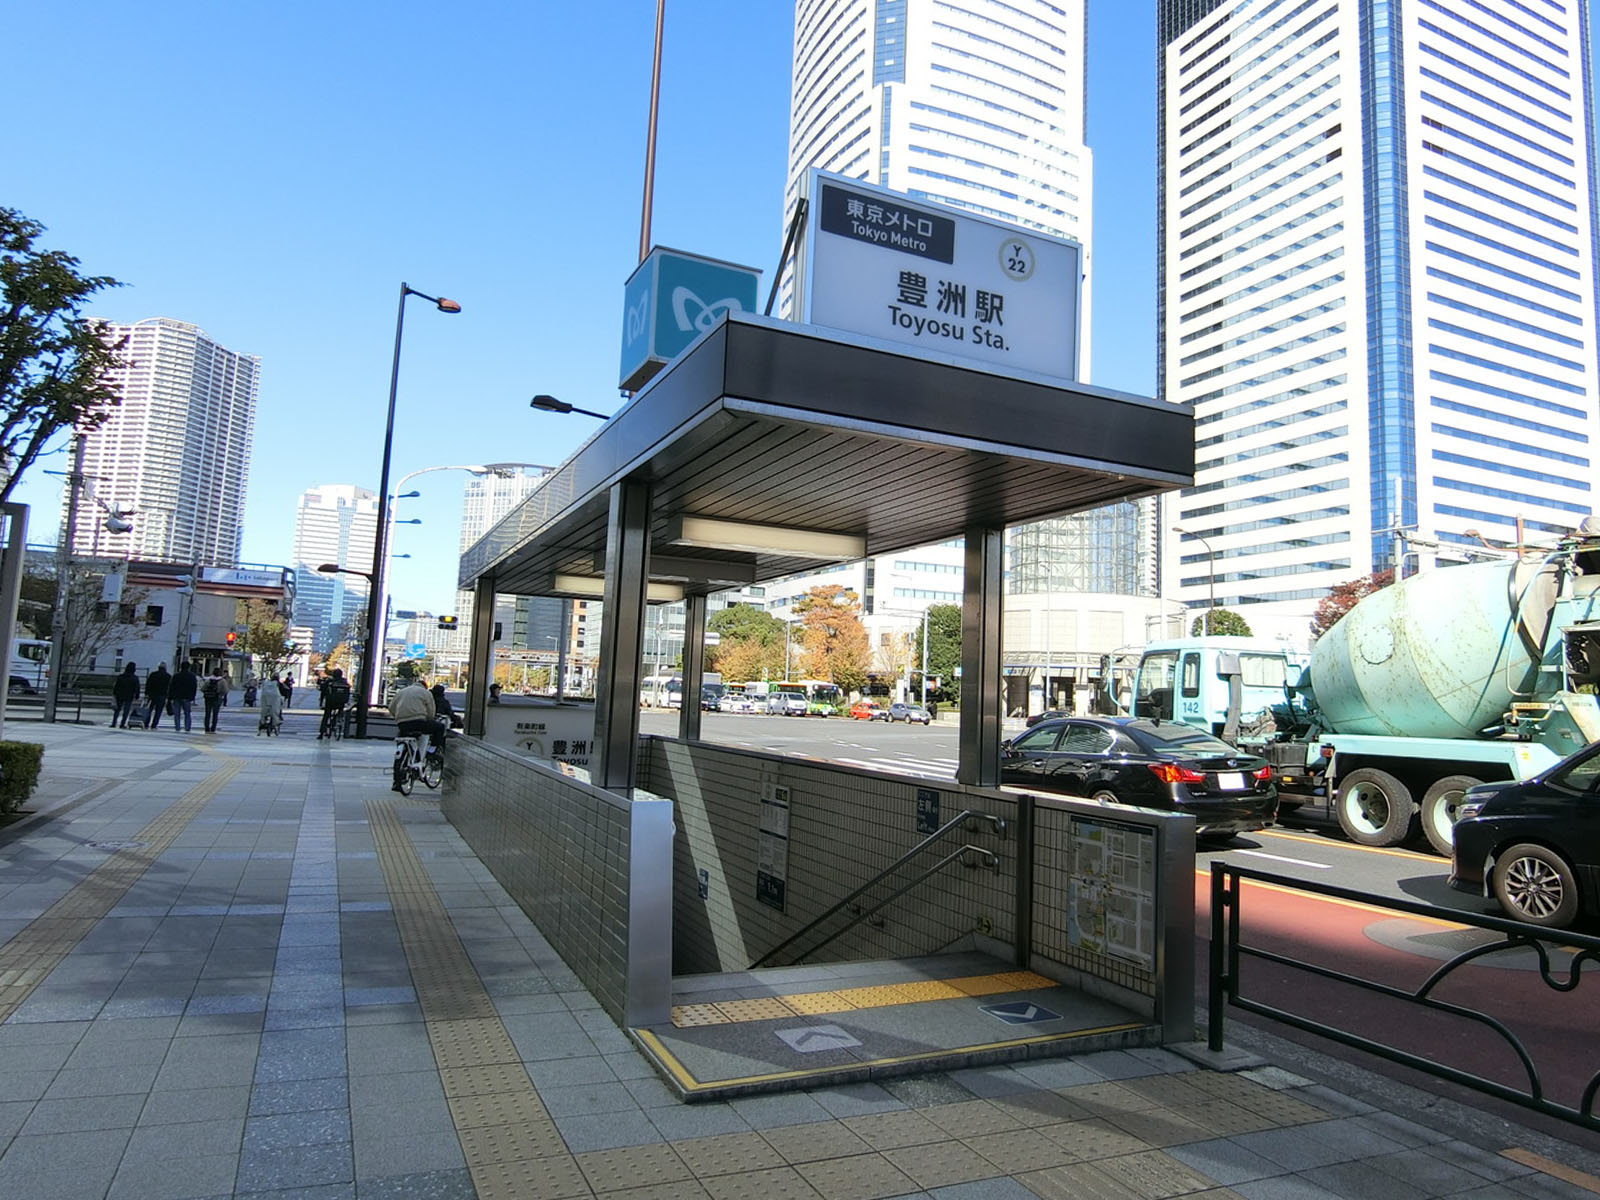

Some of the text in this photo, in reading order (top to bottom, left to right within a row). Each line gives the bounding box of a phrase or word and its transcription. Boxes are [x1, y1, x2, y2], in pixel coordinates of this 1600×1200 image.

[846, 198, 933, 237] 東京メトロ
[851, 220, 927, 252] Tokyo Metro
[1013, 244, 1022, 258] Y
[1008, 258, 1026, 274] 22
[896, 271, 1004, 327] 豊洲駅
[888, 305, 1010, 351] Toyosu Sta.
[1183, 702, 1199, 713] 142
[551, 740, 594, 755] 豊洲
